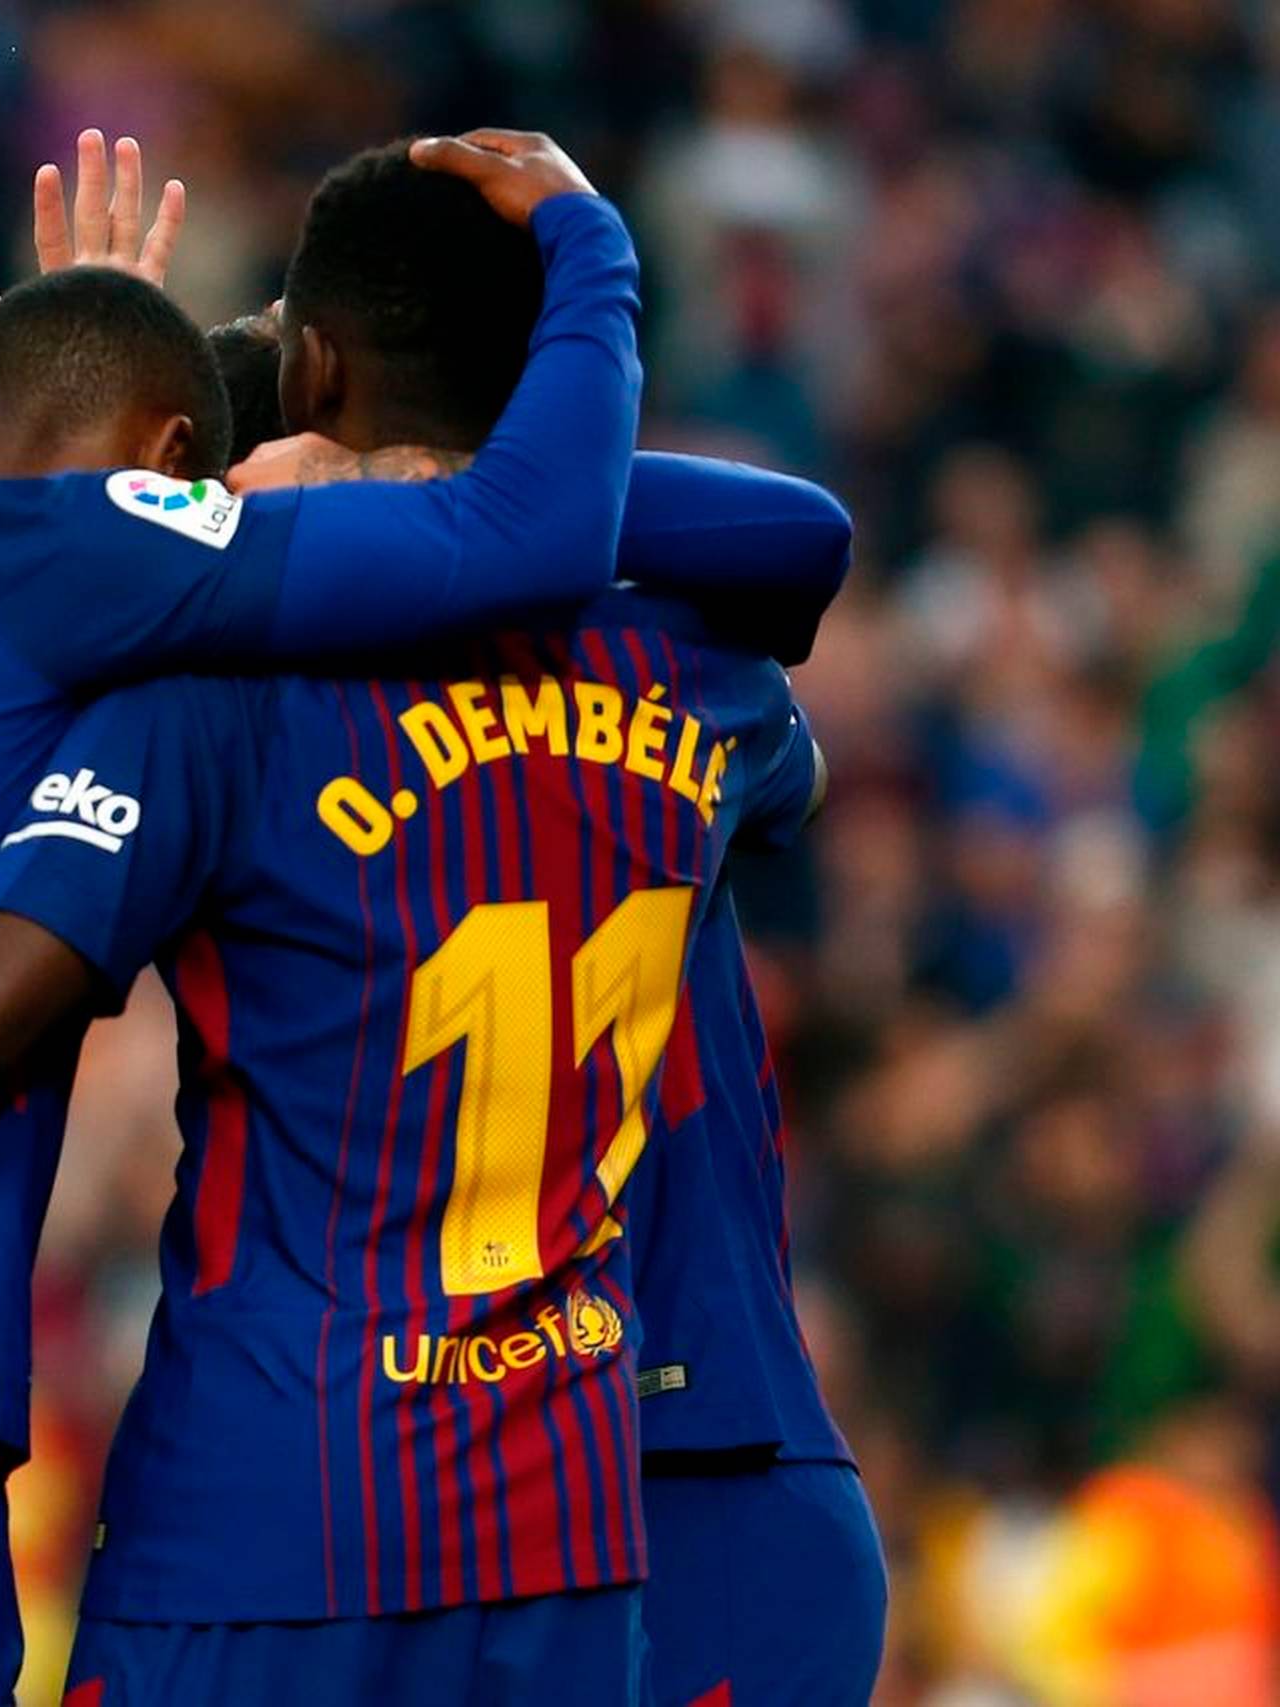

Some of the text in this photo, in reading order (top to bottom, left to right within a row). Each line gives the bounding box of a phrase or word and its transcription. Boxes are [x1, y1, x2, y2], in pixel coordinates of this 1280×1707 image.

[201, 495, 237, 533] LaLi
[30, 768, 141, 837] eko
[317, 776, 417, 857] O.
[403, 886, 694, 1296] 11
[382, 1305, 566, 1384] unicef
